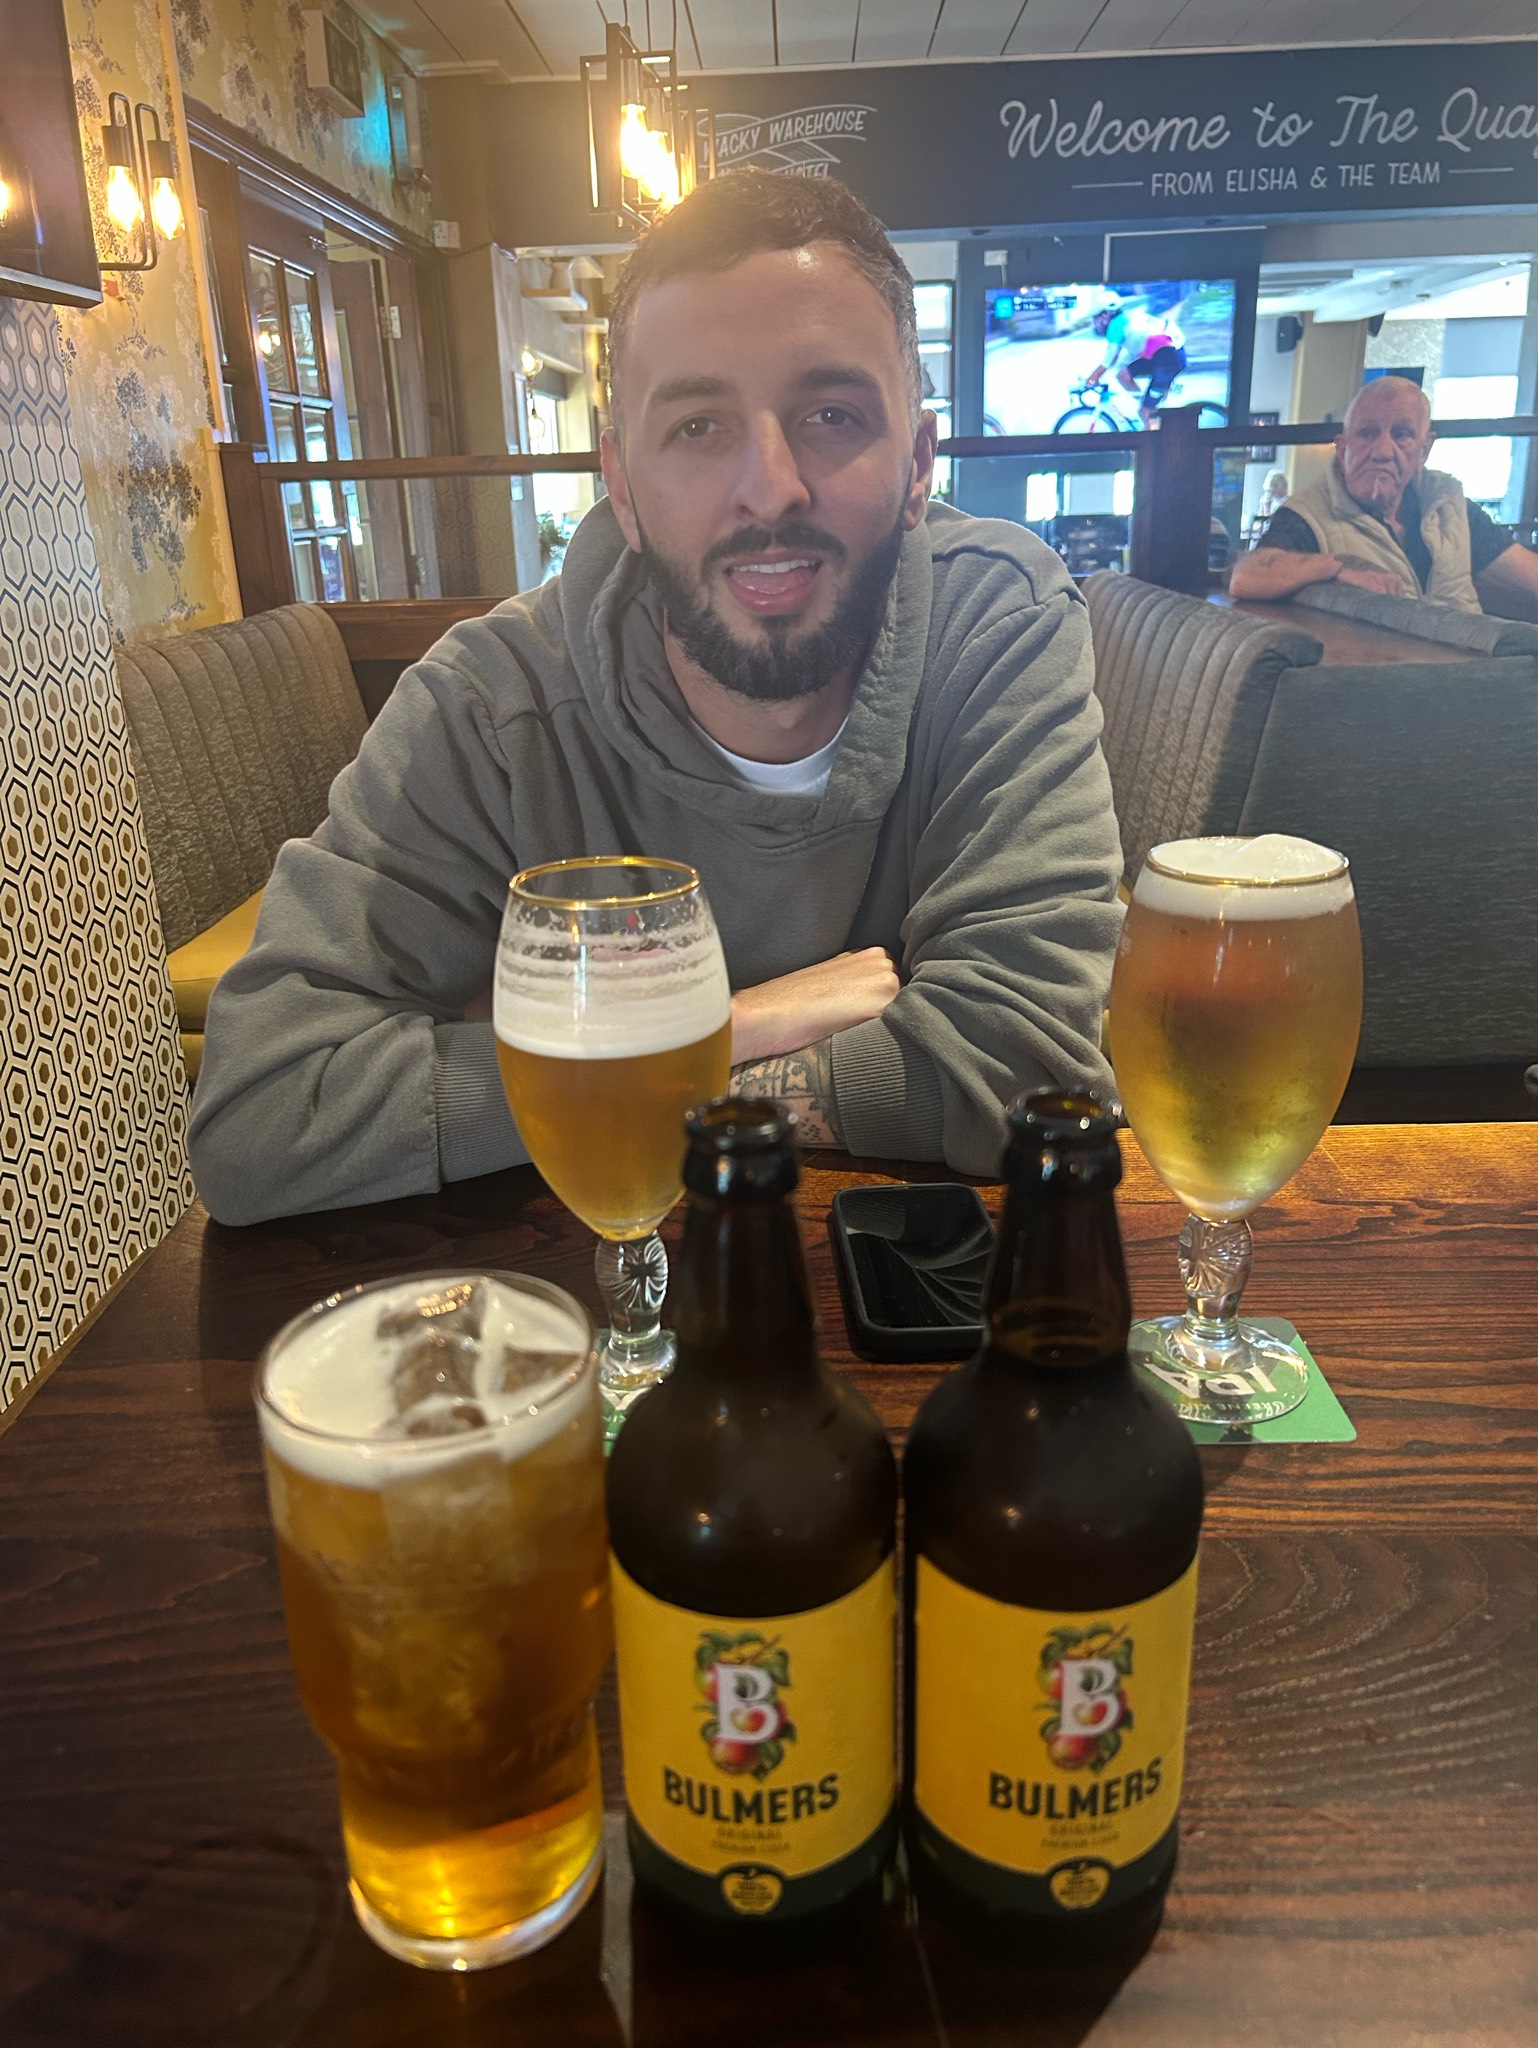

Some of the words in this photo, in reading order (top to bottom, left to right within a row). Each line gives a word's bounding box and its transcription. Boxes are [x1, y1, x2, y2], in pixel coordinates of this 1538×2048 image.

[769, 110, 867, 144] WAREHOUSE
[1000, 98, 1230, 158] Welcome
[1252, 101, 1314, 148] to
[1329, 93, 1418, 147] The
[1437, 87, 1538, 159] Qua
[1151, 171, 1213, 197] FROM
[1226, 167, 1298, 192] ELISHA
[1310, 166, 1327, 189] &
[1338, 163, 1375, 188] THE
[1388, 162, 1441, 185] TEAM
[716, 1662, 779, 1744] B
[1060, 1658, 1120, 1737] B
[663, 1765, 840, 1825] BULMERS
[987, 1756, 1163, 1820] BULMERS
